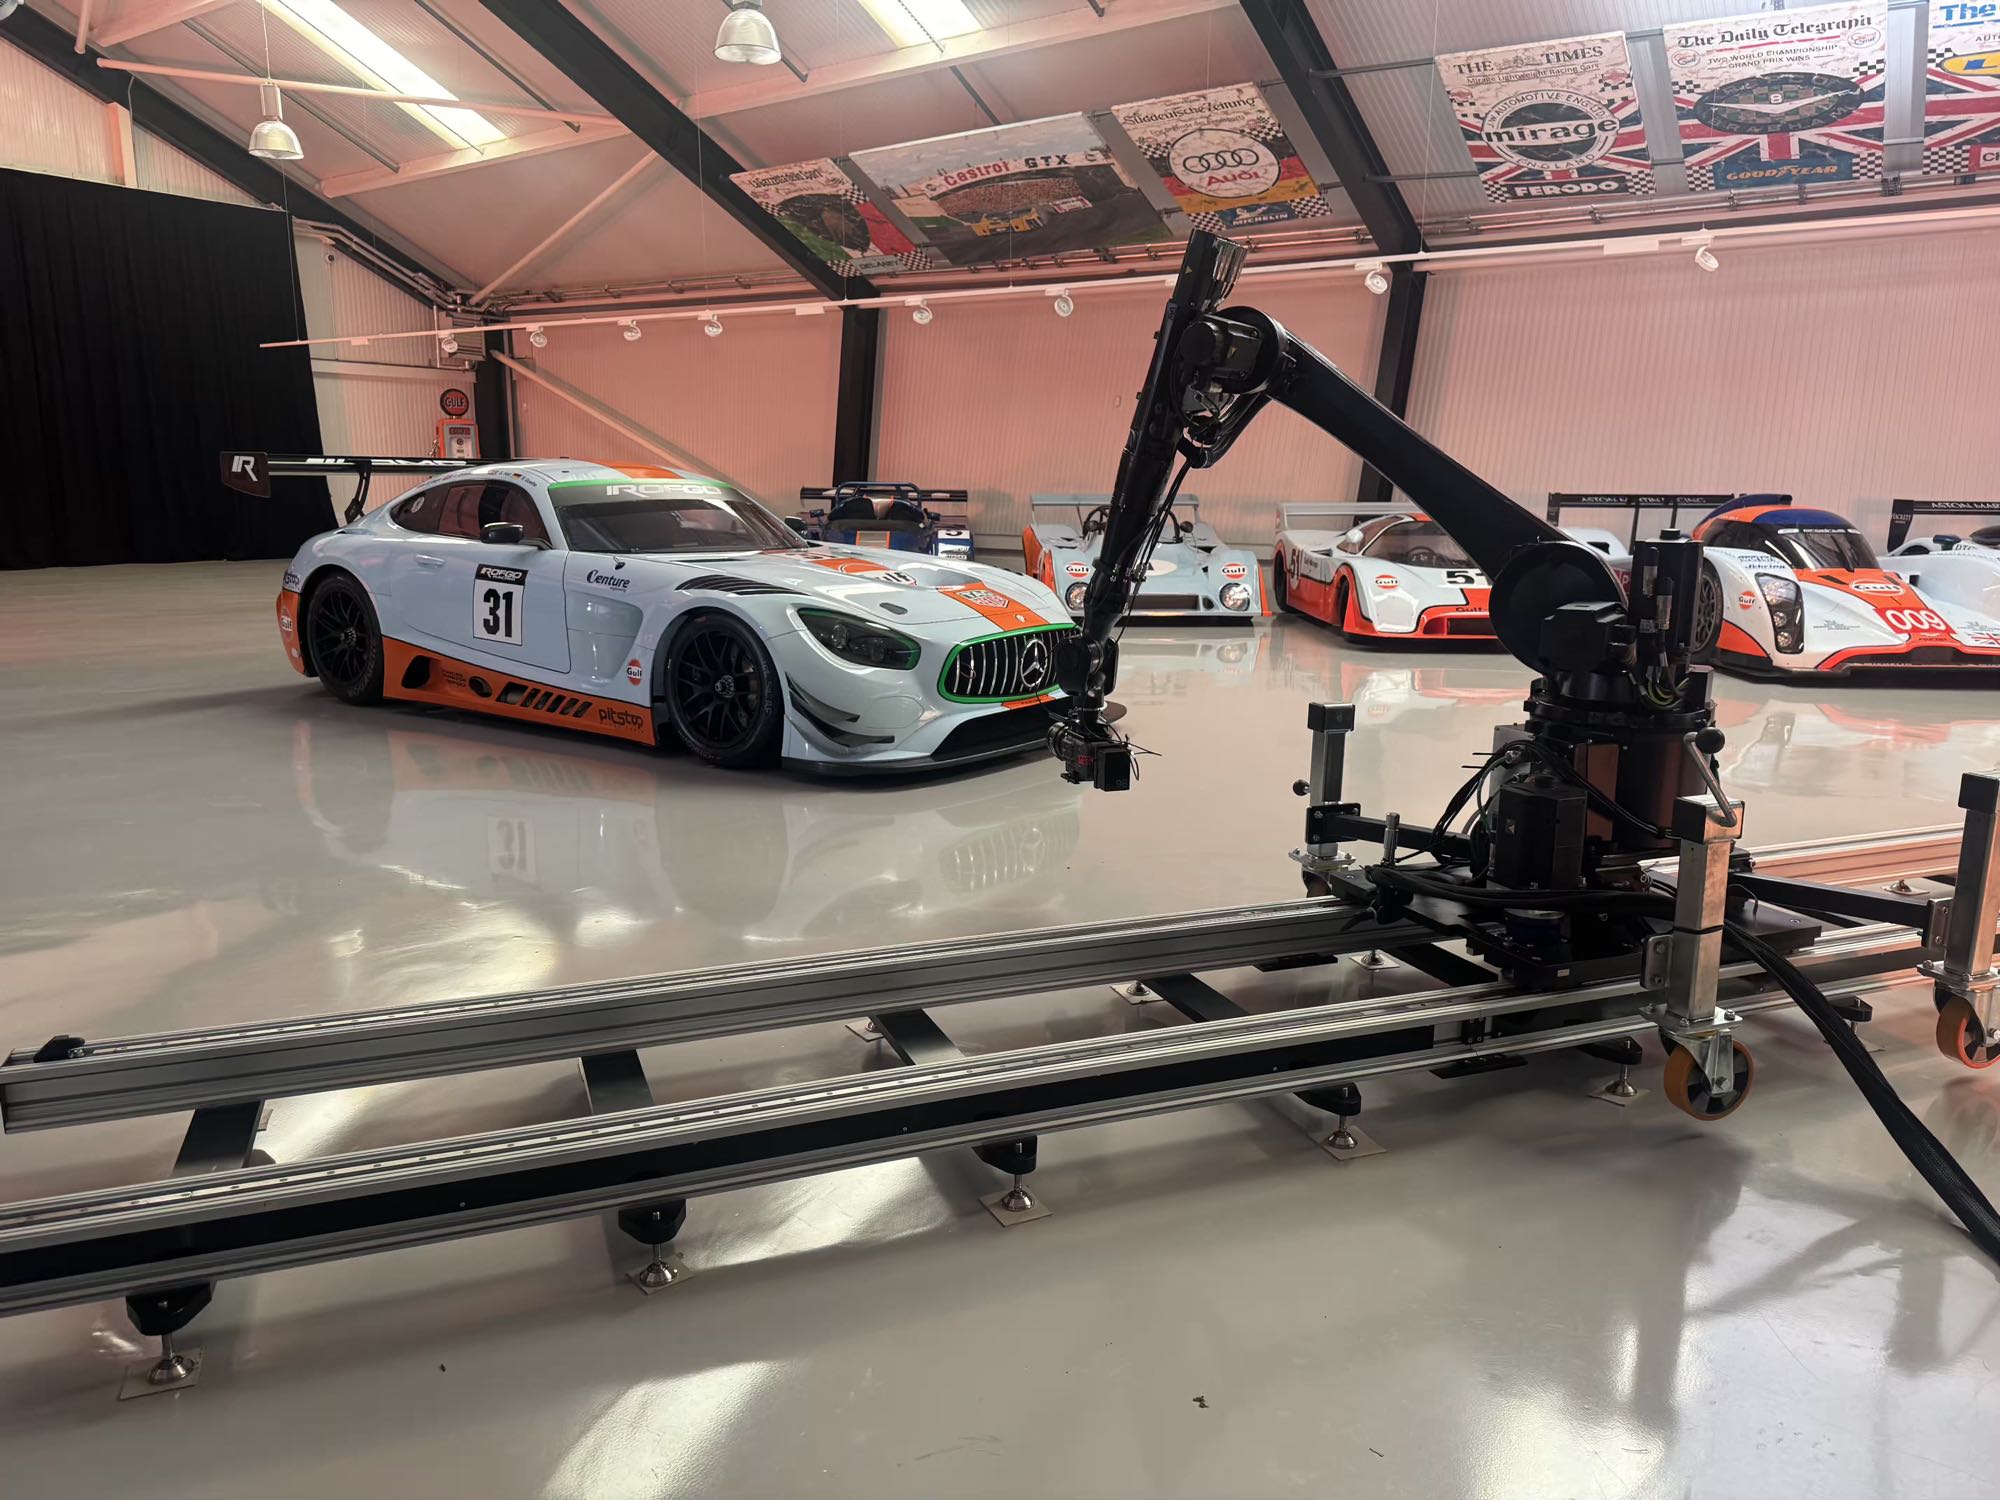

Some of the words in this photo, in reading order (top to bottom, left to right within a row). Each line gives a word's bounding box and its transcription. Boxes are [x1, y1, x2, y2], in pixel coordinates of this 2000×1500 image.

[1939, 3, 1997, 21] The
[1678, 35, 1715, 49] The
[1717, 28, 1769, 43] Daily
[1773, 15, 1872, 37] Telegraph
[1453, 60, 1494, 75] THE
[1540, 45, 1604, 64] TIMES
[1729, 51, 1764, 61] WORLD
[1766, 44, 1838, 58] CHAMPIONSHIP
[1728, 60, 1761, 69] GRAND
[1762, 57, 1784, 66] PRIX
[1786, 54, 1811, 62] WINS
[1498, 69, 1548, 82] Lightweight
[1549, 65, 1578, 76] Racing
[1579, 62, 1600, 73] Cars
[1497, 91, 1562, 116] AUTOMOTIVE
[1485, 119, 1618, 143] mirage
[1515, 153, 1596, 169] ENGLAND
[943, 161, 1010, 186] Castrol
[1024, 154, 1070, 168] GTX
[1207, 171, 1261, 187] Audi
[1513, 181, 1619, 197] FERODO
[1232, 213, 1289, 225] MICHELIN
[444, 397, 465, 408] GULF
[1066, 565, 1090, 573] Gulf
[1222, 566, 1246, 574] Gulf
[586, 569, 630, 588] Centure
[1738, 596, 1755, 604] Gulf
[483, 588, 514, 638] 31
[1885, 609, 1947, 631] 009
[627, 666, 643, 678] Gulf
